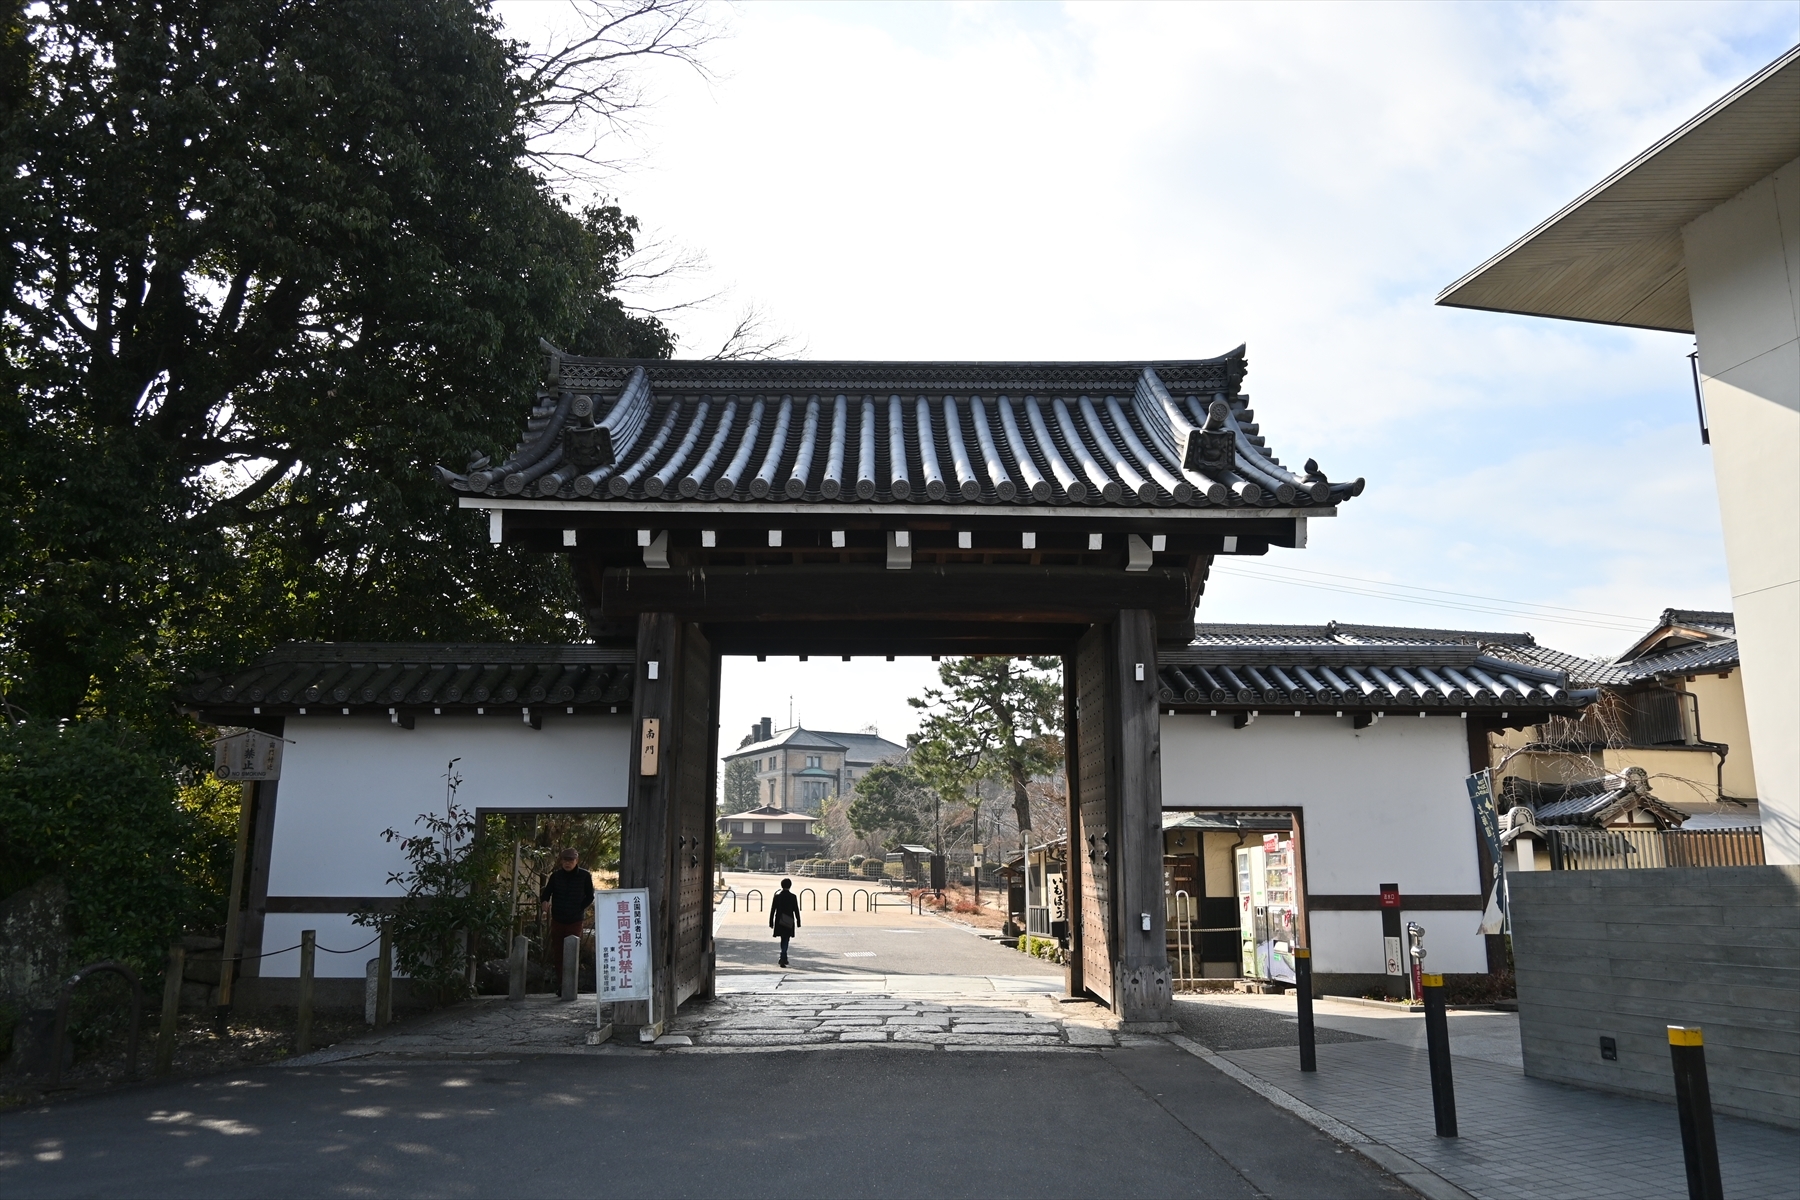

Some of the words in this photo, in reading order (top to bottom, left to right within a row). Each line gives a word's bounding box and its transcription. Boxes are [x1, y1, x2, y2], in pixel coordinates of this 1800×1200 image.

[242, 748, 255, 770] 禁止
[645, 729, 655, 755] 南門
[1052, 877, 1063, 919] いもぼう
[633, 896, 643, 947] 公園関係者以外
[617, 900, 633, 989] 車両通行禁止
